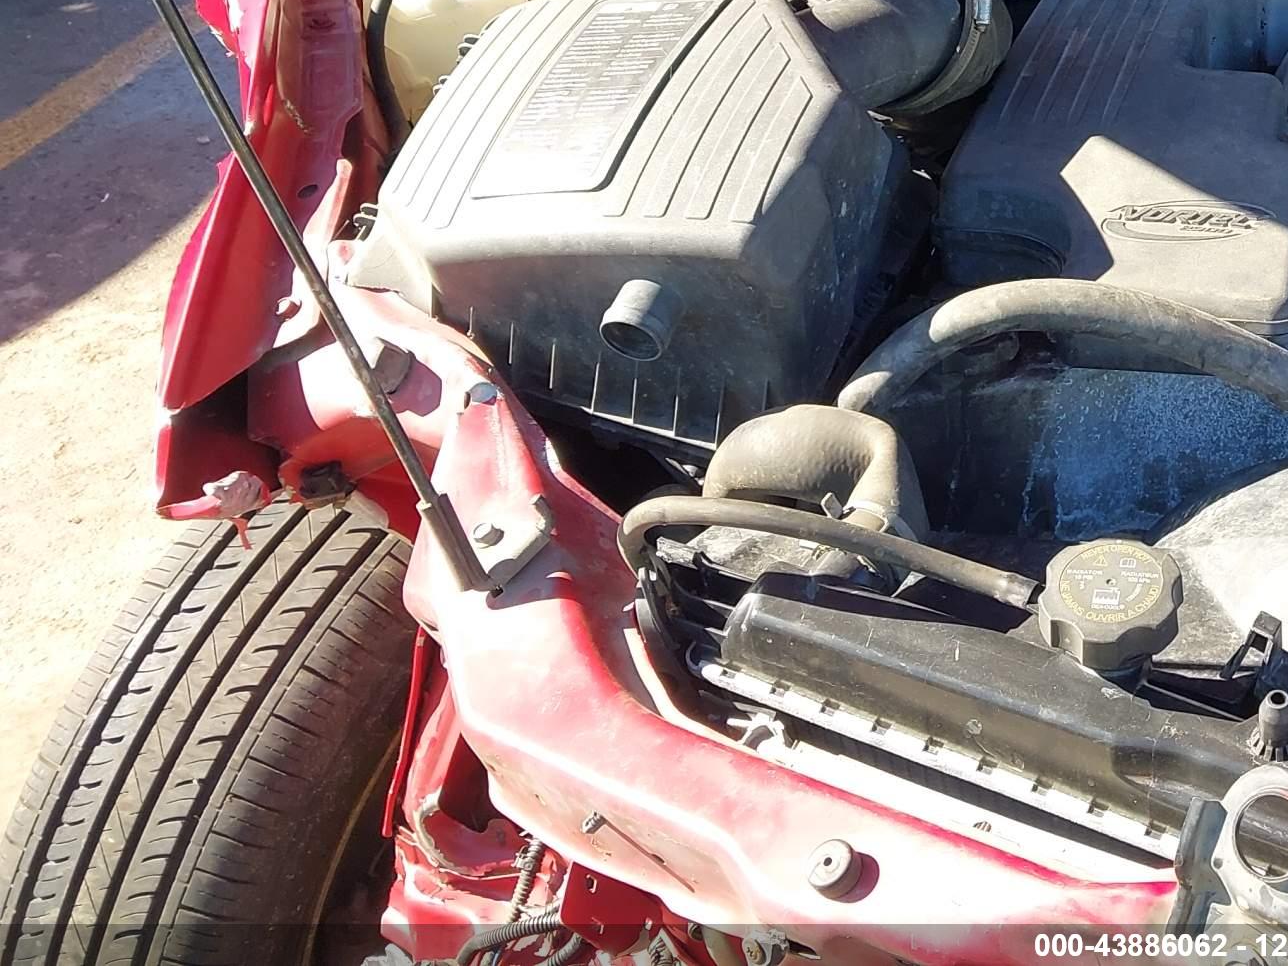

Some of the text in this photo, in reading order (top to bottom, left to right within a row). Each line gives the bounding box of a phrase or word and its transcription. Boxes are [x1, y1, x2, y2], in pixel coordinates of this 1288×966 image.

[1119, 206, 1253, 230] VORTEC
[1080, 545, 1110, 560] NEVER
[1110, 545, 1134, 556] OPEN
